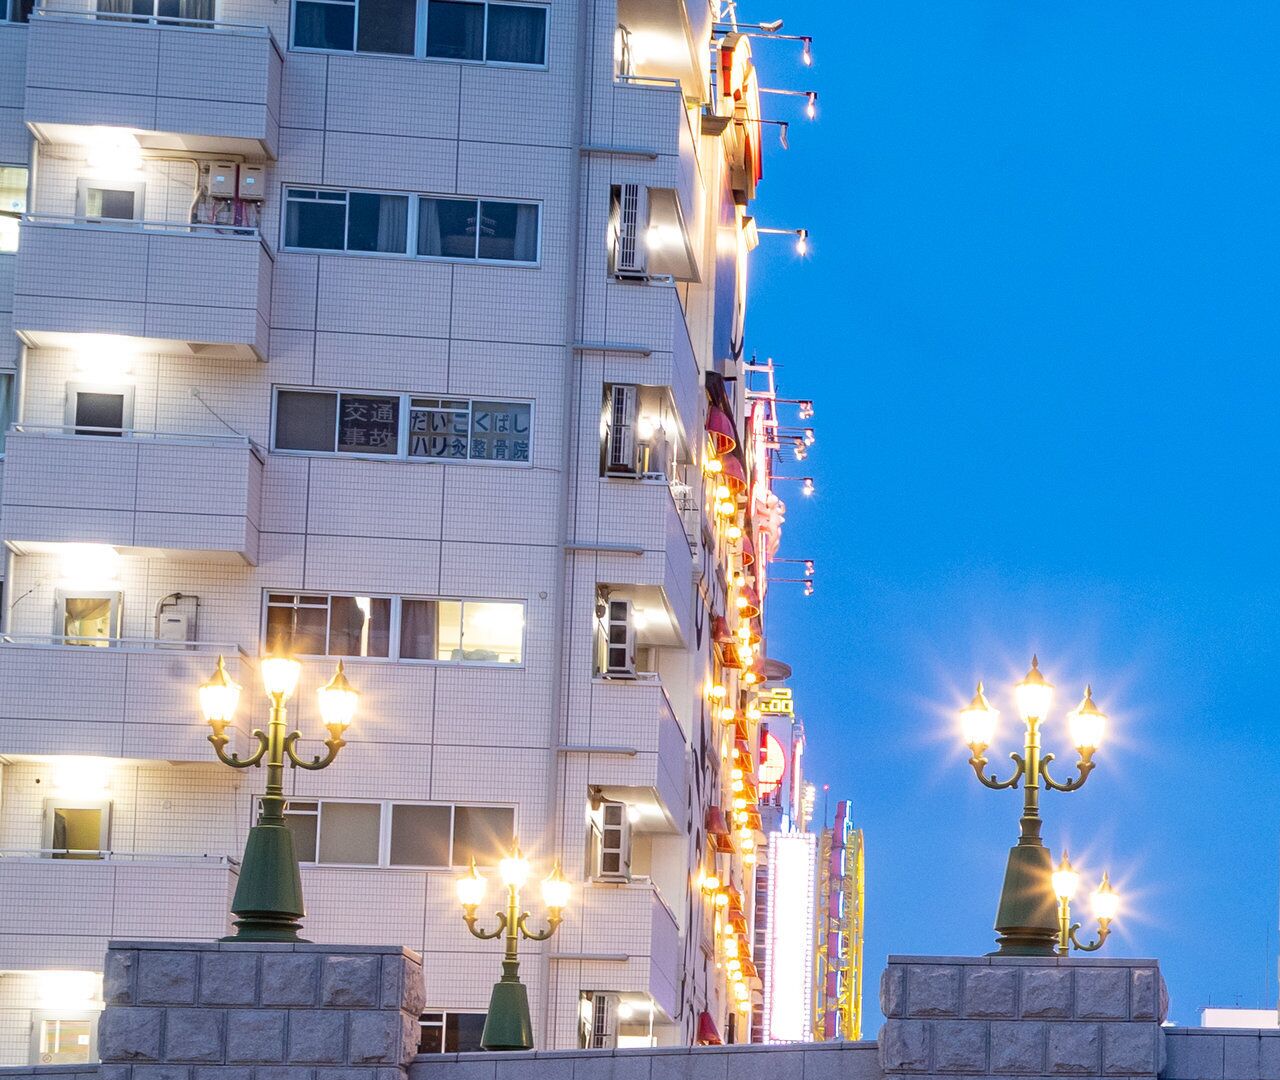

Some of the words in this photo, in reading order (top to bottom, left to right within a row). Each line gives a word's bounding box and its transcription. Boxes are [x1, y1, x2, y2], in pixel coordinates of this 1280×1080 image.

[344, 403, 394, 423] 交通
[412, 413, 528, 434] だいこくばし
[344, 427, 396, 447] 事故
[413, 436, 529, 459] ハリ灸整骨院
